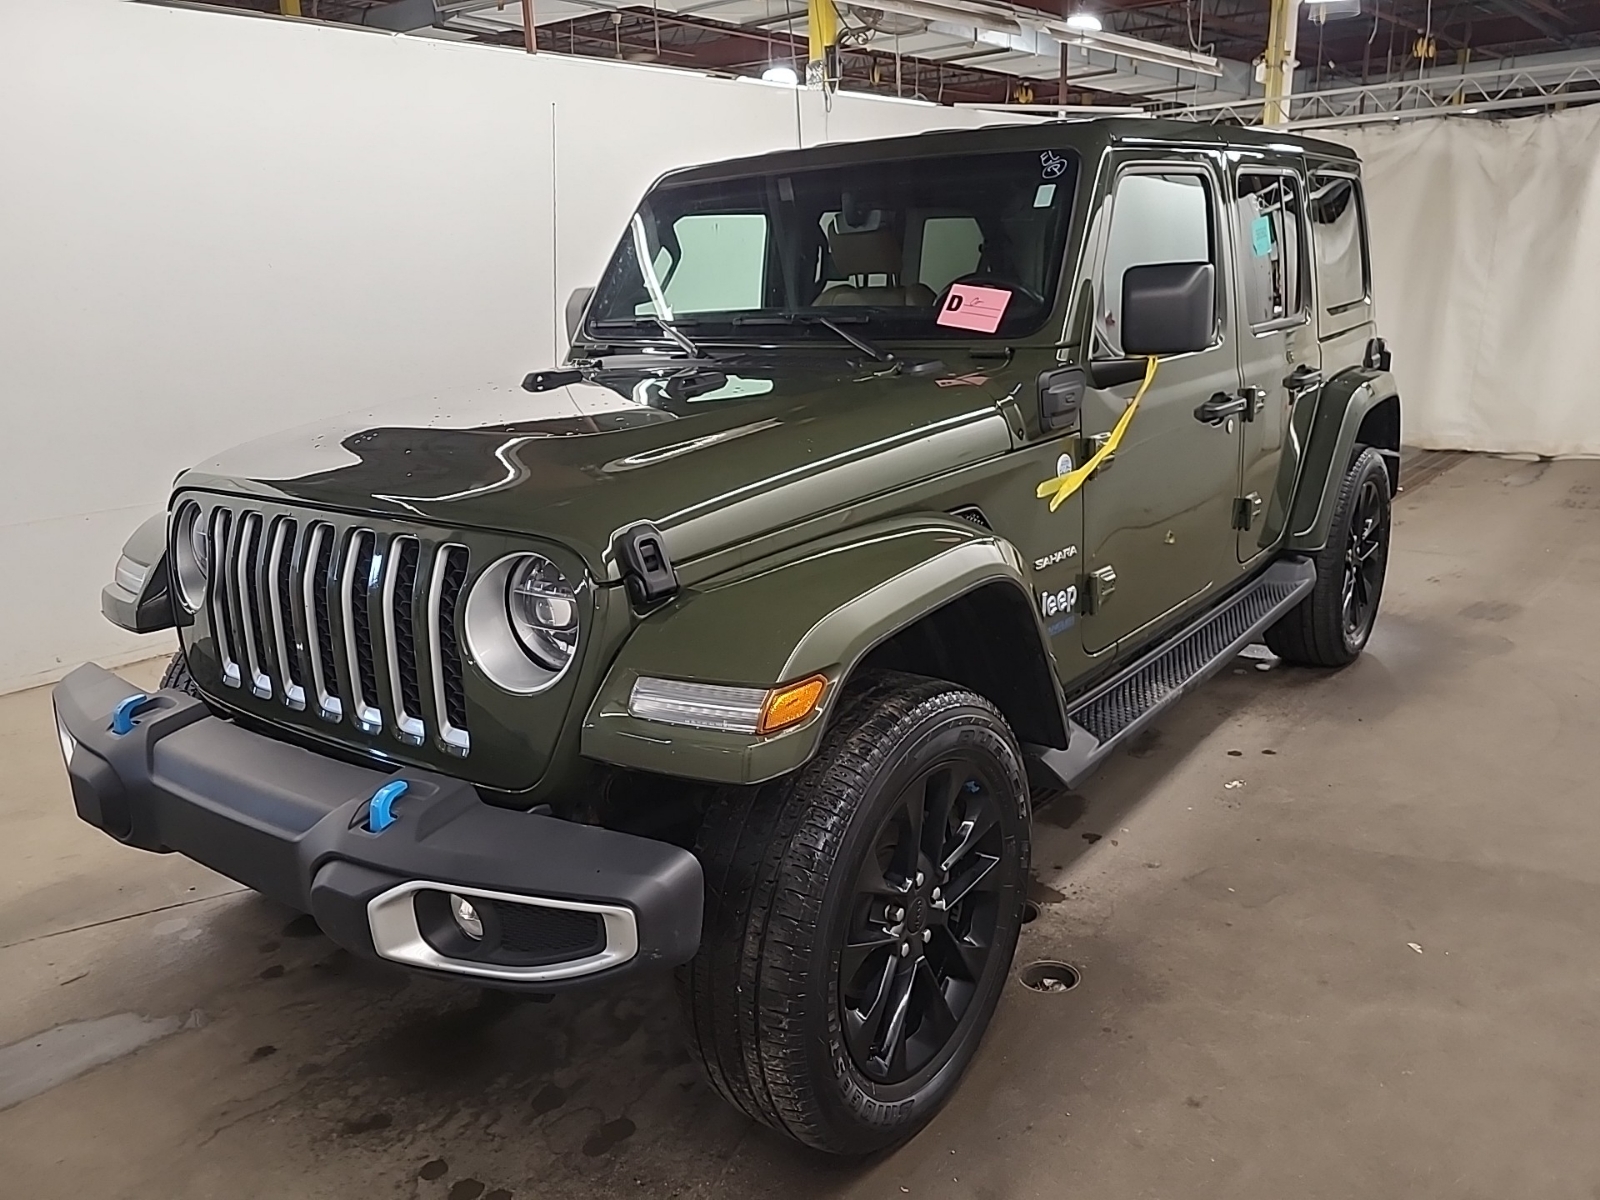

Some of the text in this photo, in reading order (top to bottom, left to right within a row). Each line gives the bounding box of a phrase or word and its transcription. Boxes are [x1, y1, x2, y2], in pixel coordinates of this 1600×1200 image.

[945, 294, 964, 312] D
[1034, 545, 1078, 570] SAHARA
[1041, 585, 1078, 618] Jeep
